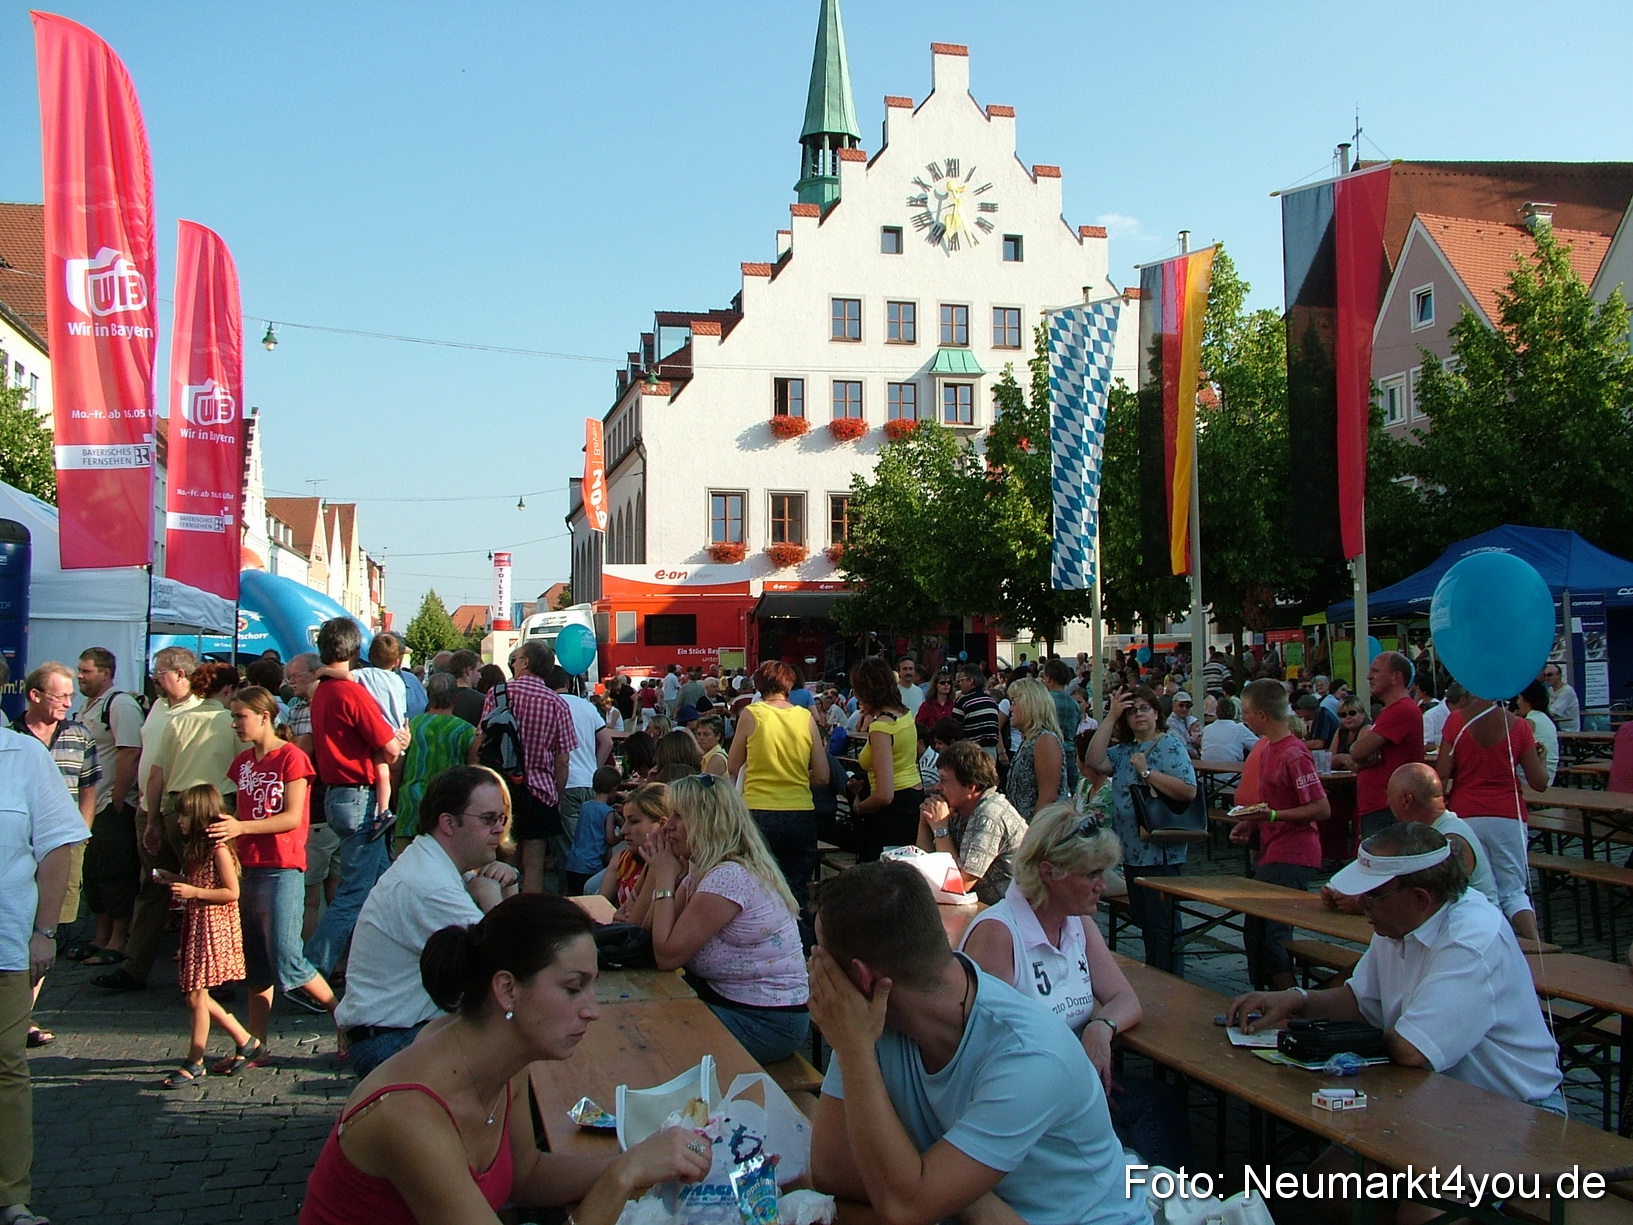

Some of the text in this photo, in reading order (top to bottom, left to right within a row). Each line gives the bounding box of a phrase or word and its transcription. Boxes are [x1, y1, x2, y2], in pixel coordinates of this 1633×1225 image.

[68, 322, 154, 340] Wir in Bayern
[72, 409, 106, 419] Mo.-Fr.
[108, 409, 121, 418] ab
[180, 427, 196, 439] Wir
[198, 429, 208, 440] in
[82, 448, 132, 457] BAYERISCHES
[82, 457, 132, 466] FERNSEHEN
[694, 572, 715, 580] Bayern
[1032, 961, 1052, 996] 5
